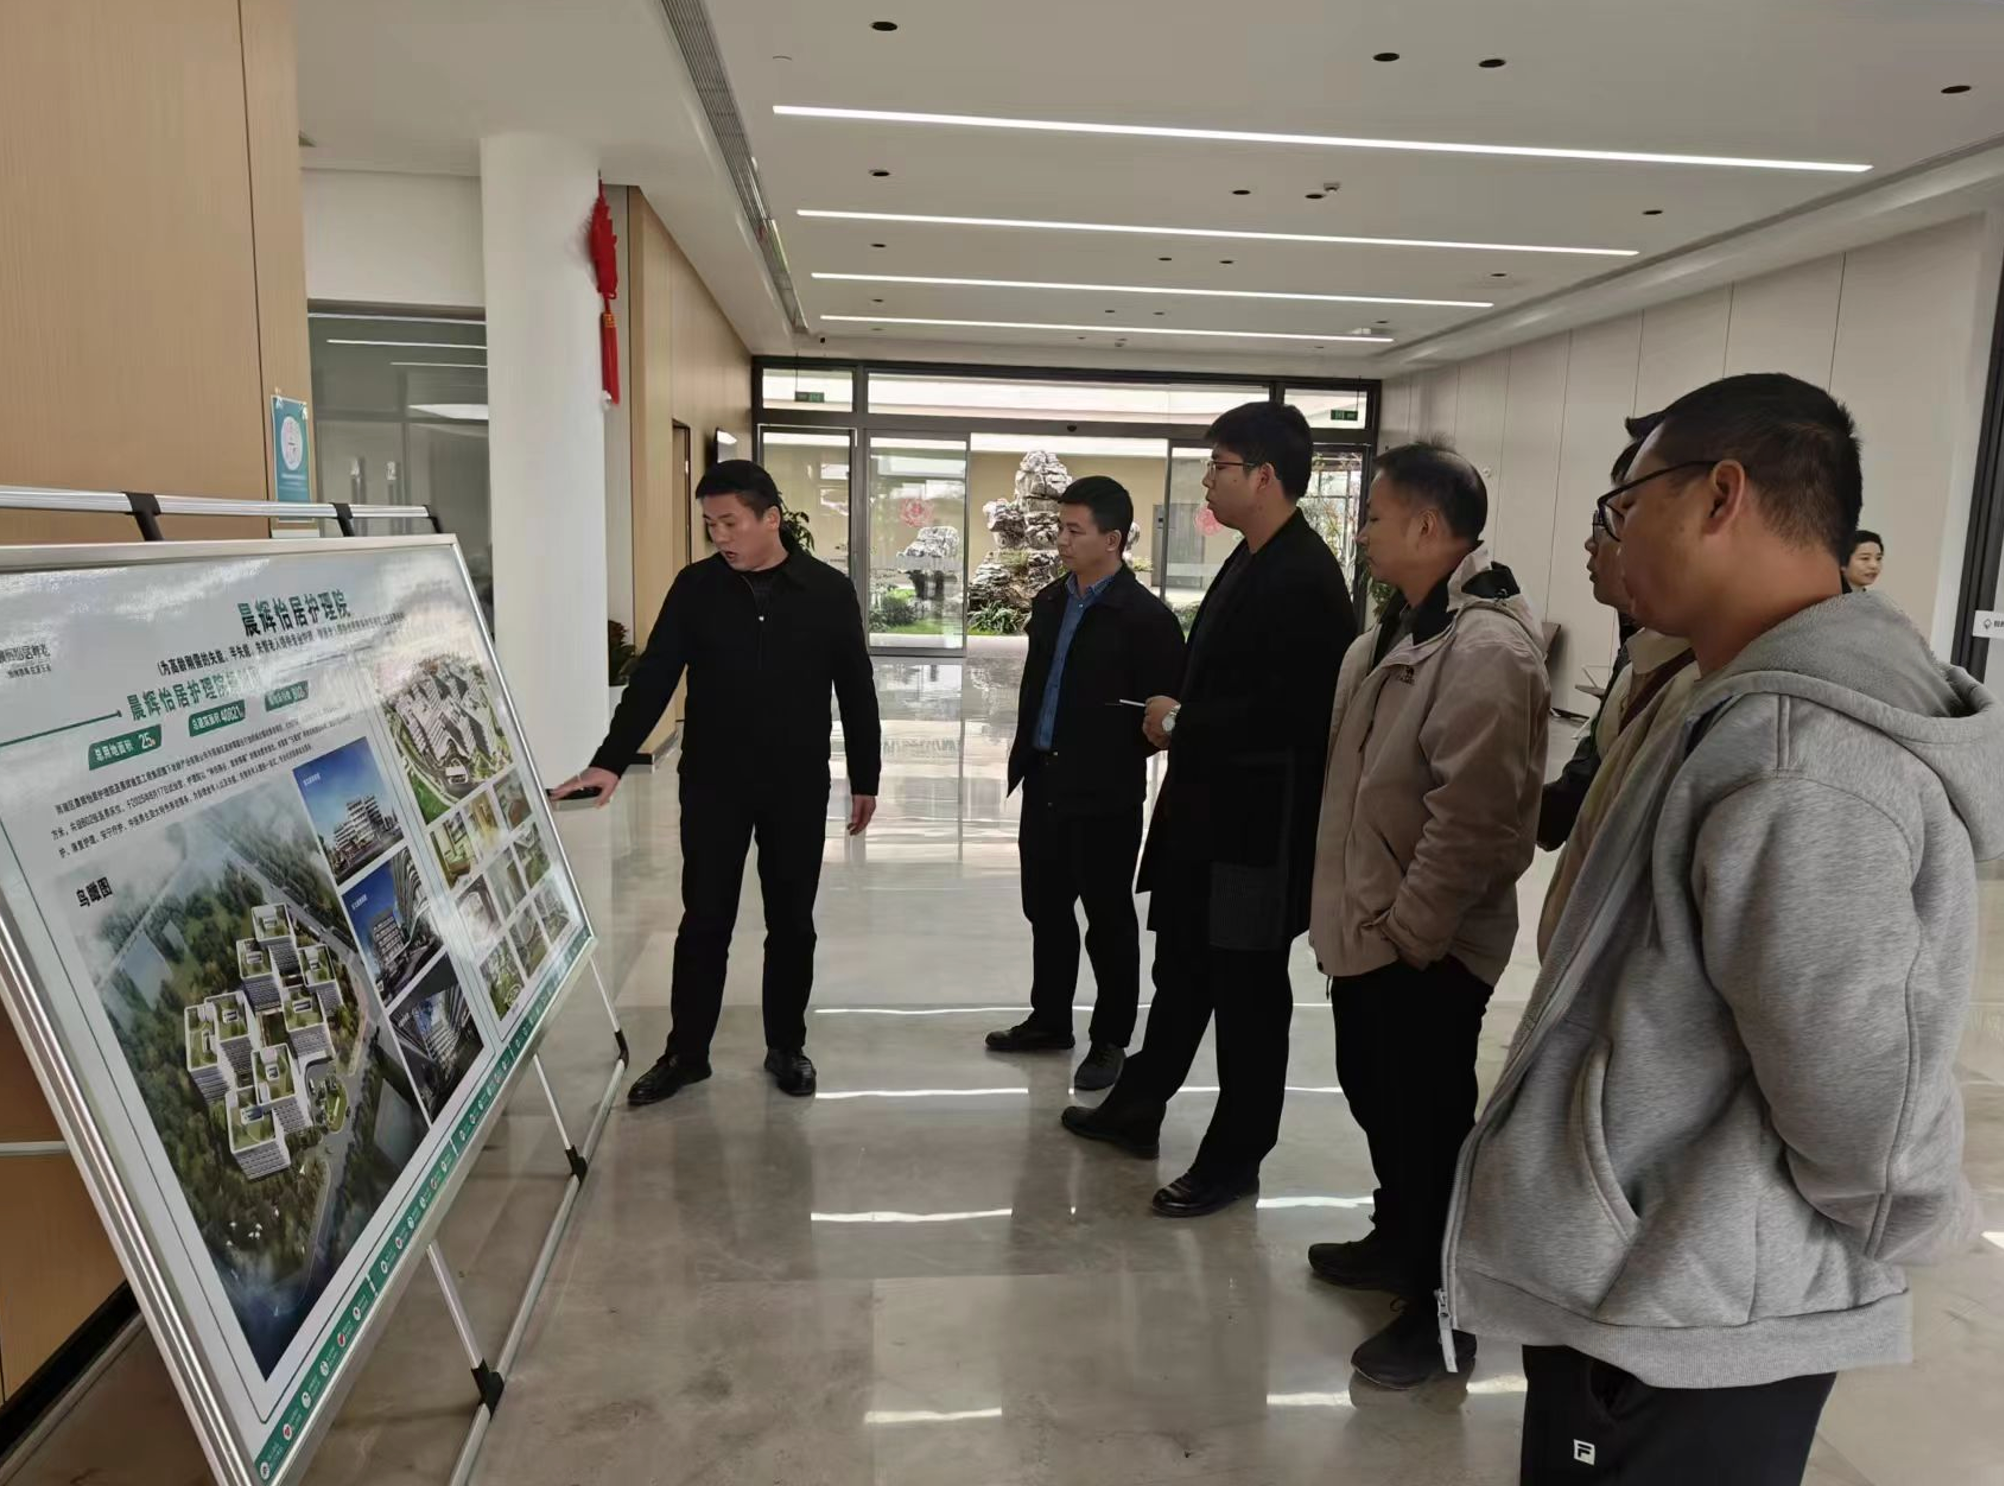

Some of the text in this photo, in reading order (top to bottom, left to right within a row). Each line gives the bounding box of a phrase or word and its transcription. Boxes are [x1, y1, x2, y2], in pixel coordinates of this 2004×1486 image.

[237, 589, 351, 638] 晨辉怡居护理院
[76, 876, 113, 907] 鸟瞰图
